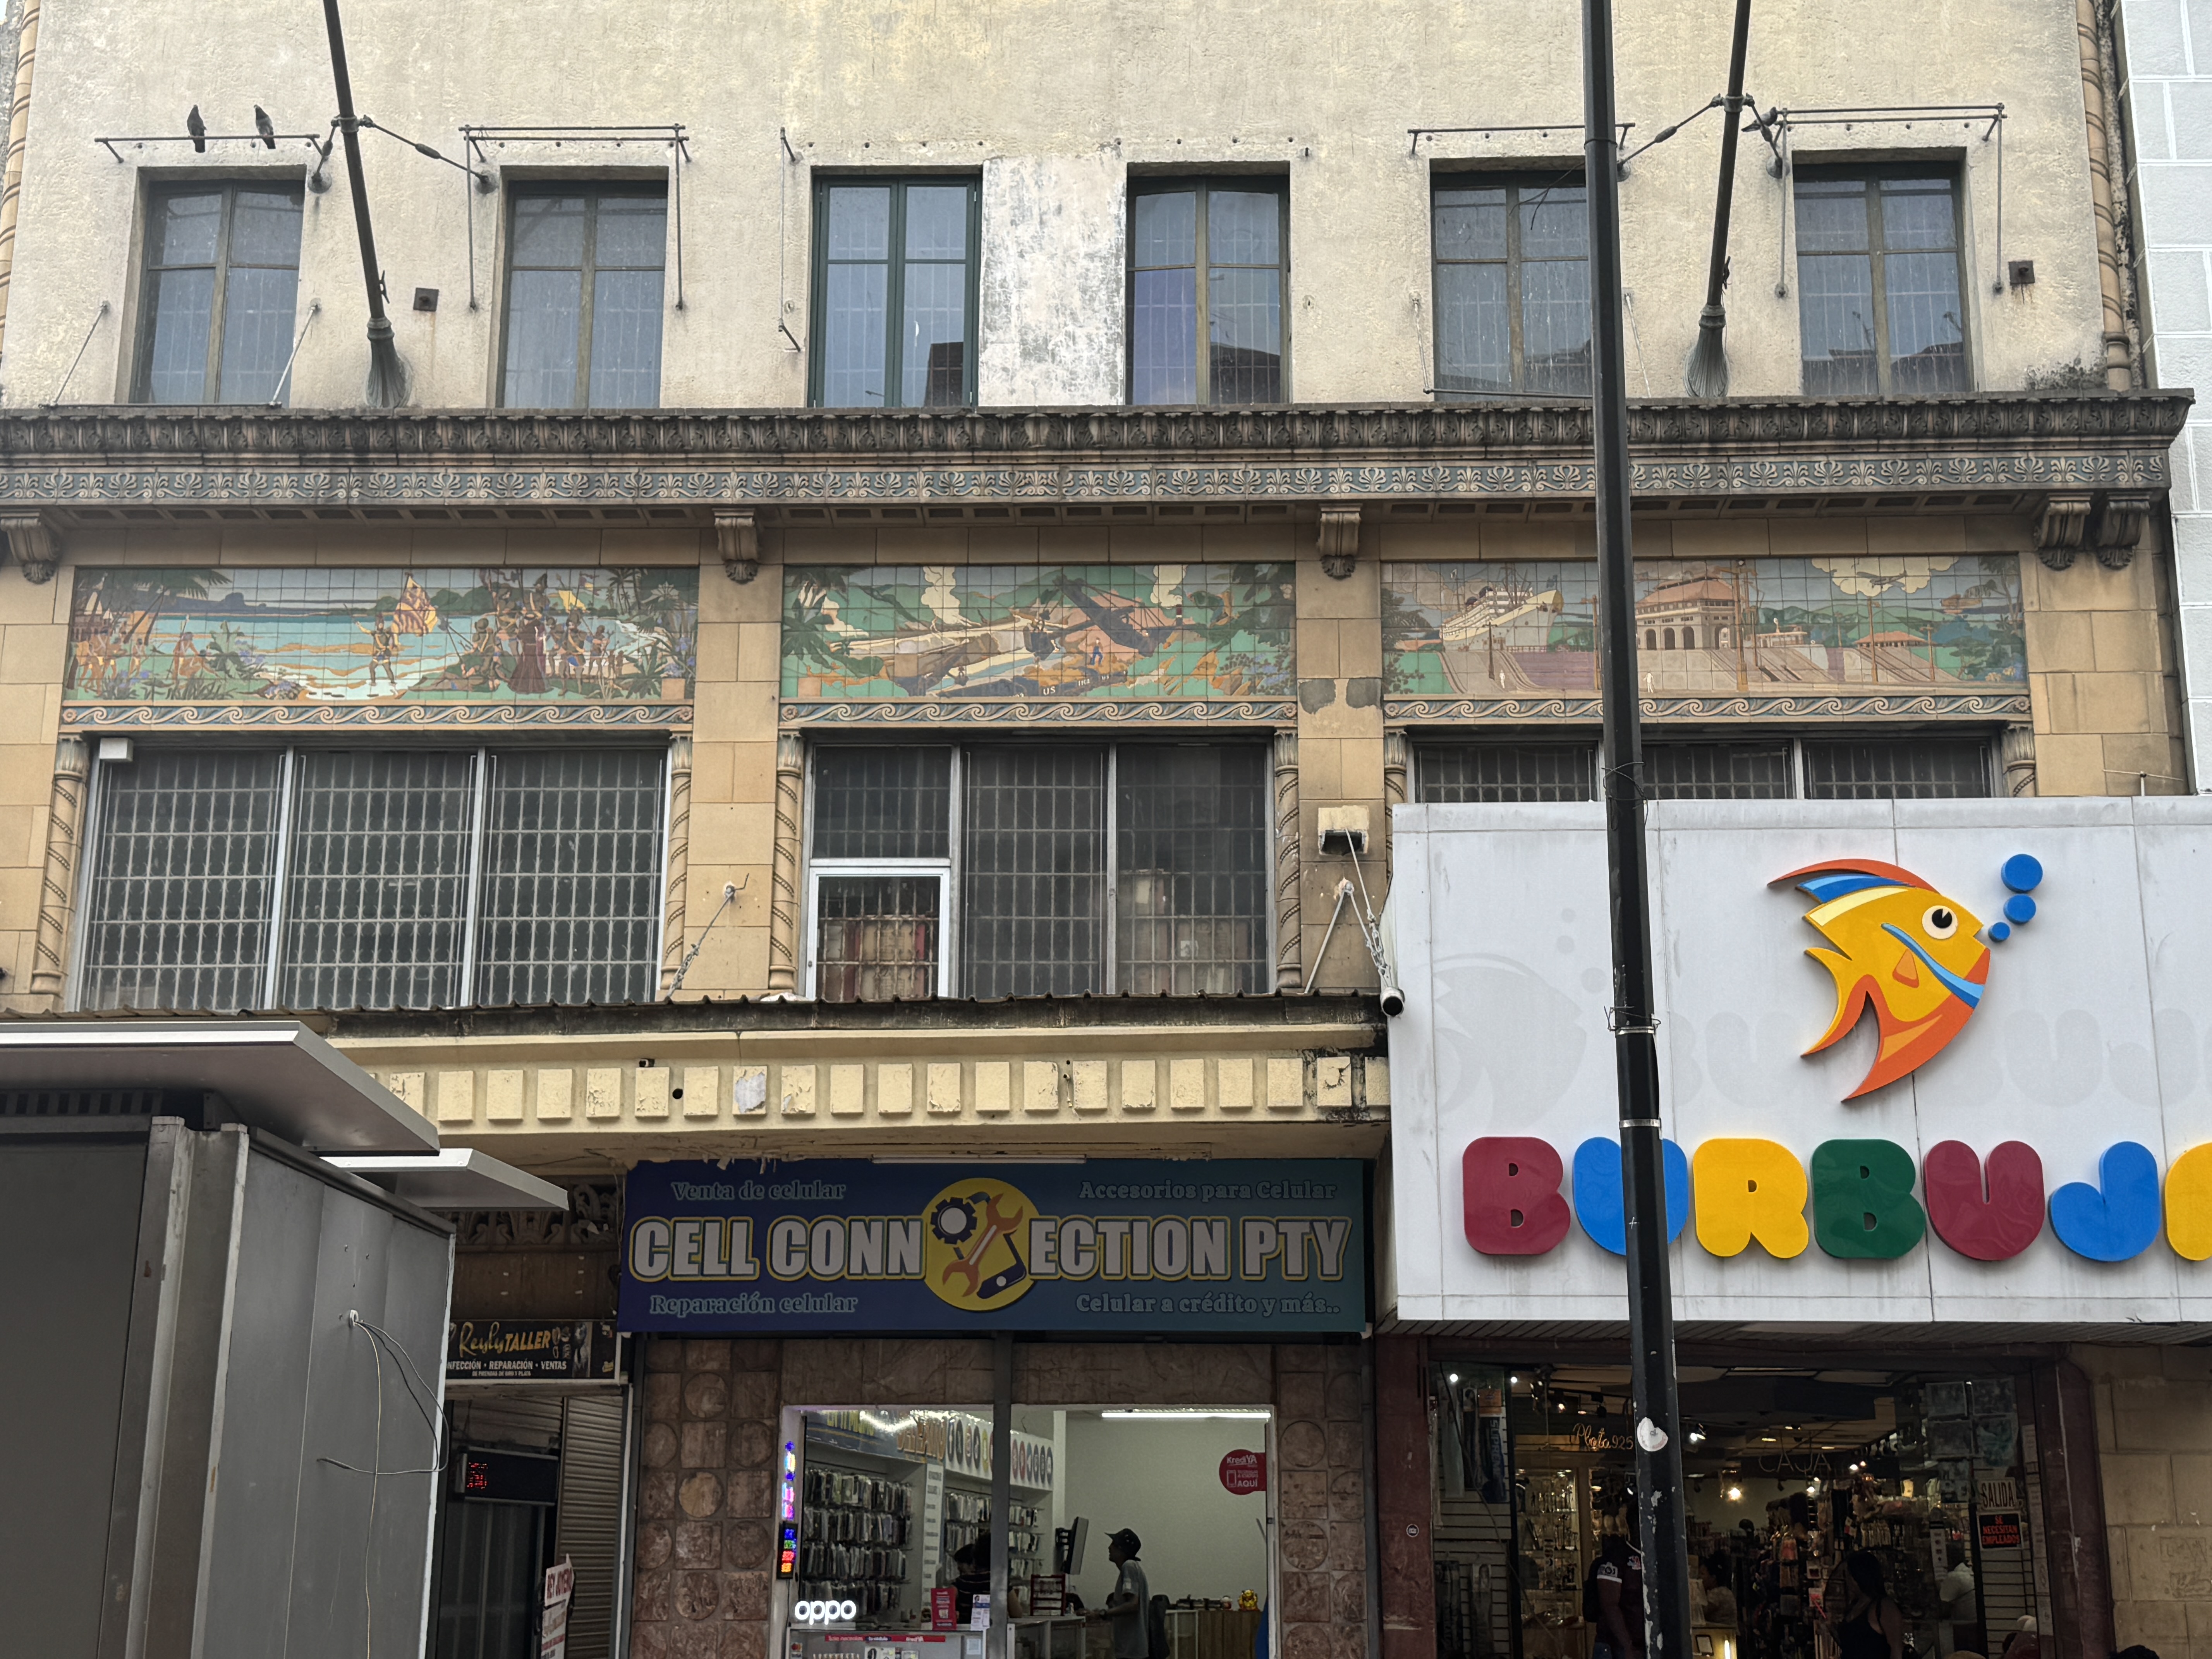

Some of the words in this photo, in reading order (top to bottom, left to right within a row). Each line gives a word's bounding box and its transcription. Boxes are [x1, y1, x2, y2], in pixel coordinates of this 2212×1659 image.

[1043, 686, 1056, 695] US
[672, 1182, 734, 1201] Venta
[739, 1180, 764, 1200] de
[769, 1181, 846, 1200] celular
[1079, 1179, 1197, 1200] Accesorios
[1202, 1182, 1252, 1202] para
[1256, 1180, 1337, 1200] Celular
[629, 1216, 760, 1282] CELL
[766, 1215, 926, 1281] CONN
[1029, 1214, 1231, 1281] ECTION
[1240, 1215, 1352, 1281] PTY
[650, 1291, 775, 1318] Reparación
[780, 1293, 858, 1313] celular
[1076, 1293, 1156, 1314] Celular
[1161, 1298, 1175, 1314] a
[1178, 1291, 1257, 1314] crédito
[1262, 1297, 1274, 1317] y
[505, 1330, 551, 1352] TALLER
[489, 1358, 533, 1370] REPARACIÓN
[541, 1360, 567, 1370] VENTAS
[1612, 1434, 1633, 1450] 925
[1758, 1451, 1832, 1473] CAJA
[1981, 1482, 2015, 1508] SALIDA
[795, 1600, 856, 1625] oppo
